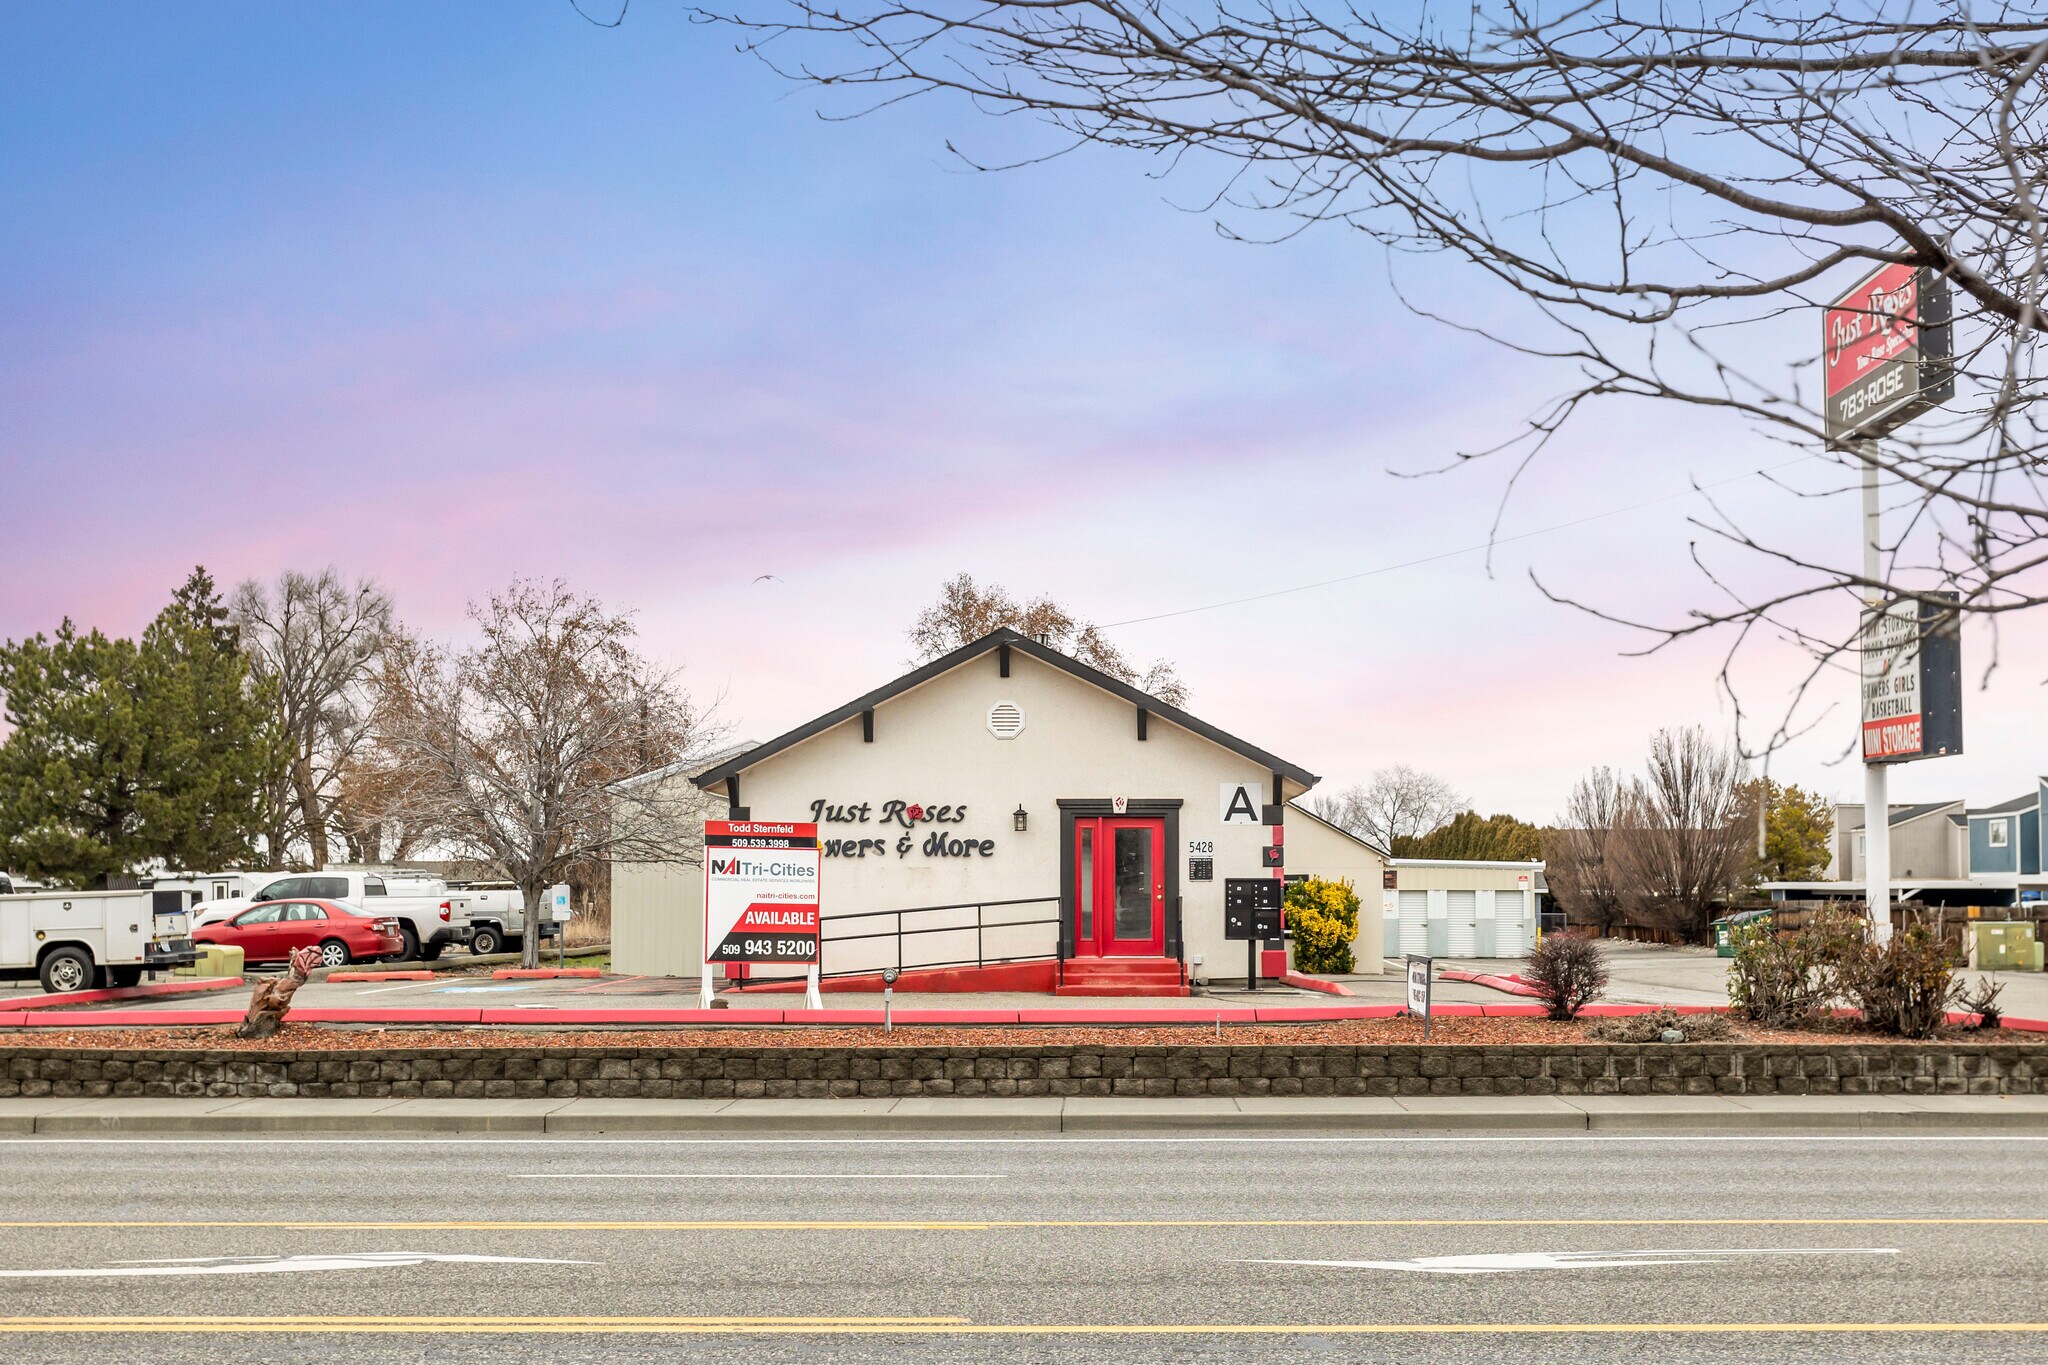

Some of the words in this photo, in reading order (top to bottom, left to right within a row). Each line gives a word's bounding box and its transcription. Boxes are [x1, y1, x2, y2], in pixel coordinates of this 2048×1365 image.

[1830, 312, 1863, 368] Just
[1868, 278, 1912, 336] Roses
[1840, 365, 1905, 422] 783-ROSE
[1894, 674, 1915, 694] GIRLS
[1872, 696, 1912, 718] BASKETBALL
[1864, 727, 1882, 755] MINI
[1882, 721, 1920, 754] STORAGE
[810, 799, 871, 823] Just
[1223, 786, 1259, 821] A
[728, 823, 751, 833] Todd
[753, 824, 794, 834] Sternfeld
[731, 838, 790, 848] 509.539.3998
[821, 838, 886, 858] wers
[896, 831, 914, 859] &
[923, 831, 995, 858] More
[1189, 841, 1214, 853] 5428
[742, 861, 815, 877] Tri-Cities
[756, 892, 816, 900] naitri-cities.com
[745, 911, 815, 925] AVAILABLE
[722, 944, 741, 955] 509
[745, 940, 772, 955] 943
[776, 940, 816, 956] 5200
